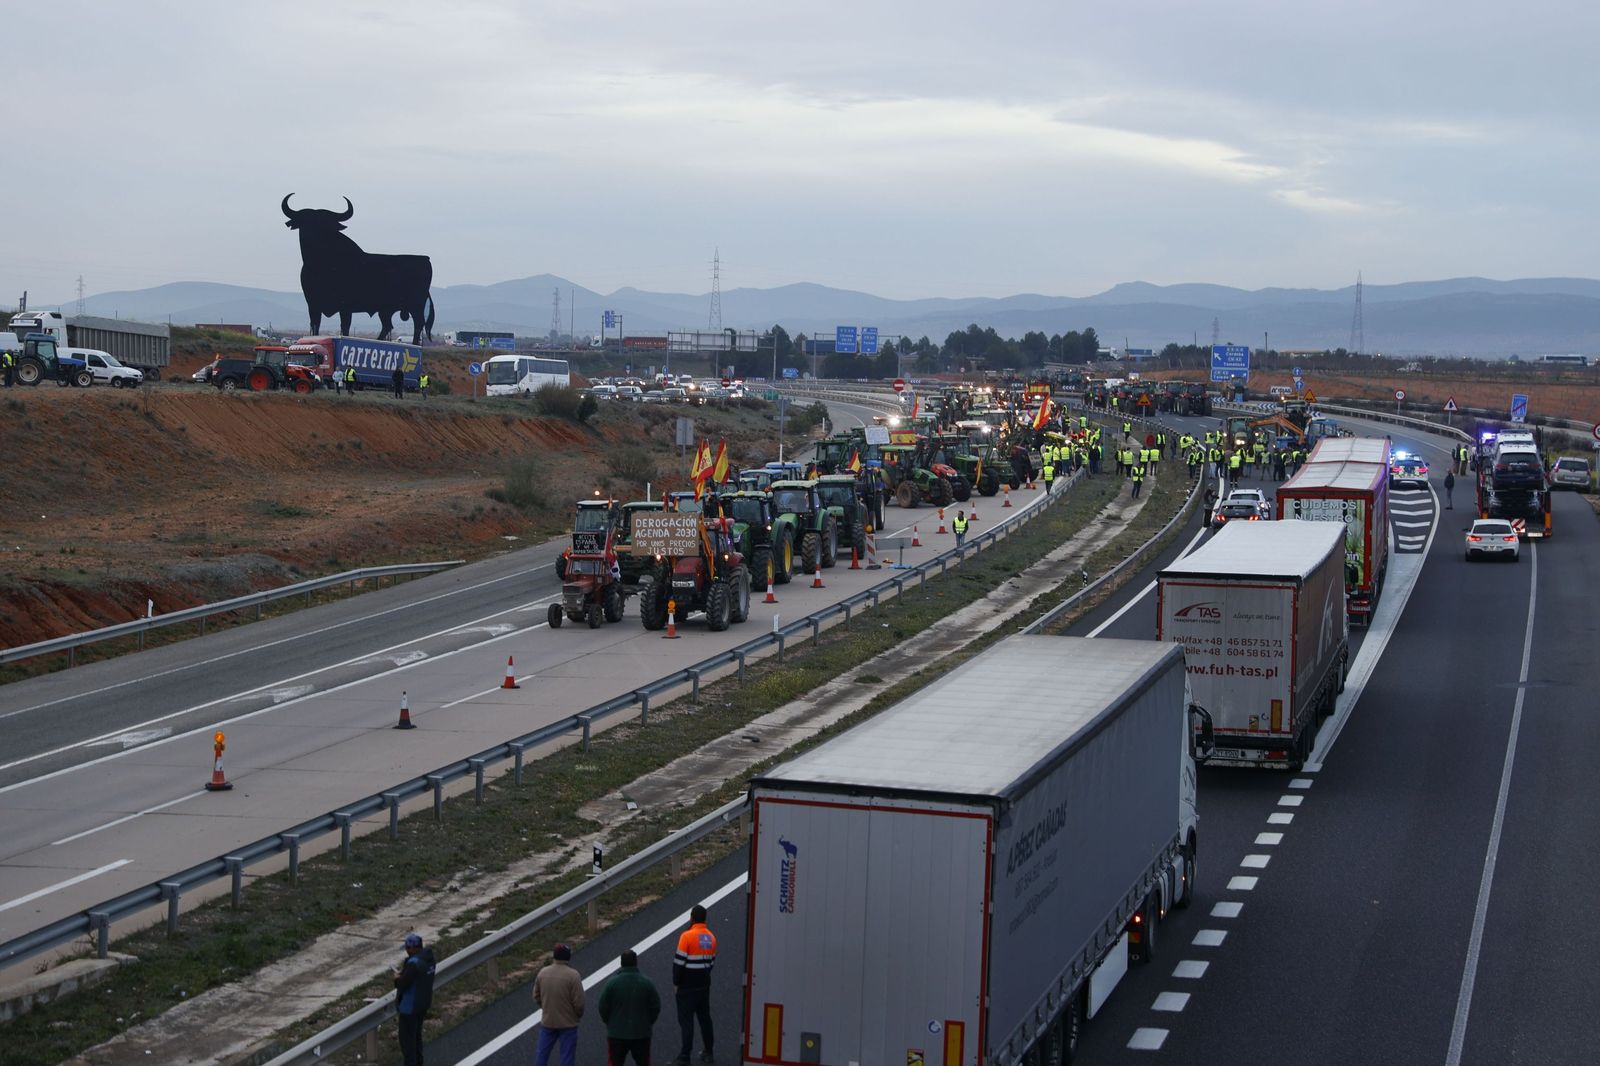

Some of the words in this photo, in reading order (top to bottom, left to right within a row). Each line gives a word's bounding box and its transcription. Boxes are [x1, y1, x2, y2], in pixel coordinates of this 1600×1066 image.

[341, 345, 400, 371] carreras
[1293, 501, 1356, 510] CUIDEMOS
[635, 515, 697, 528] DEROGACIÓN
[1295, 513, 1354, 523] NUESTRO
[635, 528, 670, 538] AGENDA
[675, 528, 697, 537] 2030
[636, 540, 648, 548] POR
[669, 540, 696, 548] PRECIOS
[646, 547, 685, 555] JUSTOS
[1196, 607, 1221, 618] TAS
[1173, 635, 1202, 645] tel/fax
[1204, 637, 1222, 645] +48
[1227, 637, 1240, 646] 46
[1241, 638, 1258, 646] 857
[1260, 639, 1270, 647] 51
[1272, 639, 1283, 647] 71
[1185, 646, 1201, 655] bile
[1203, 647, 1221, 655] +48
[1227, 648, 1244, 656] 604
[1247, 649, 1258, 657] 58
[1260, 649, 1270, 657] 61
[1273, 650, 1284, 658] 74
[1185, 663, 1278, 679] ww.fuh-tas.pl
[780, 859, 789, 912] SCHMITZ
